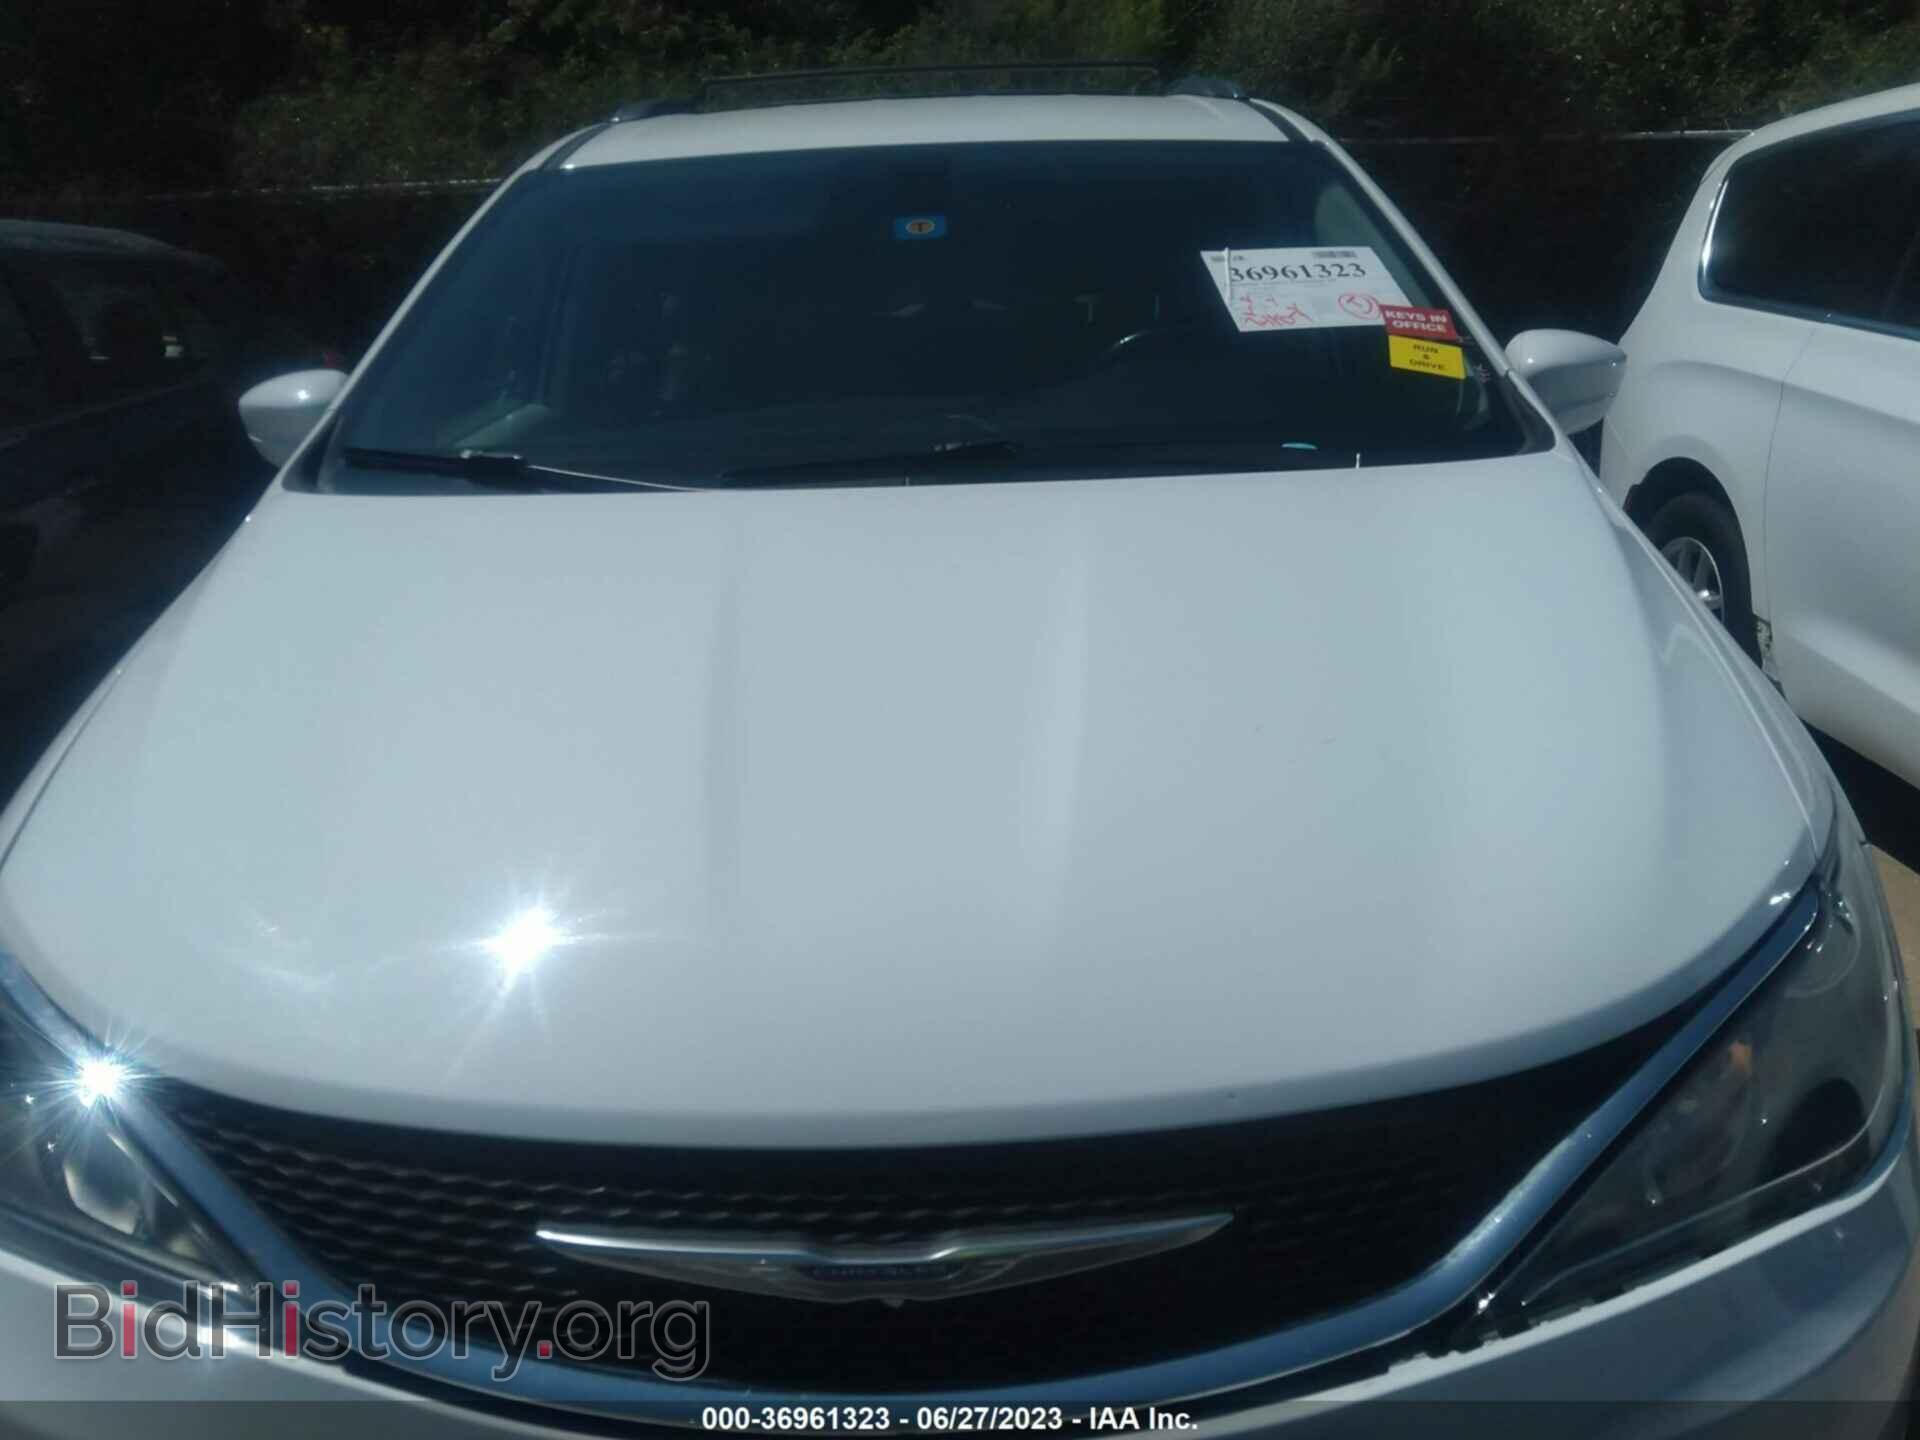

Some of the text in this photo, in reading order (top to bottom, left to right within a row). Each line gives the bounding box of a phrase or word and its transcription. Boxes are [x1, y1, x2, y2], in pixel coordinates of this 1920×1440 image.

[1230, 262, 1367, 283] 36961323
[1385, 310, 1448, 323] KEYS IN
[1391, 319, 1447, 333] OFFICE
[1412, 343, 1439, 354] RUN
[1408, 359, 1446, 370] DRIVE
